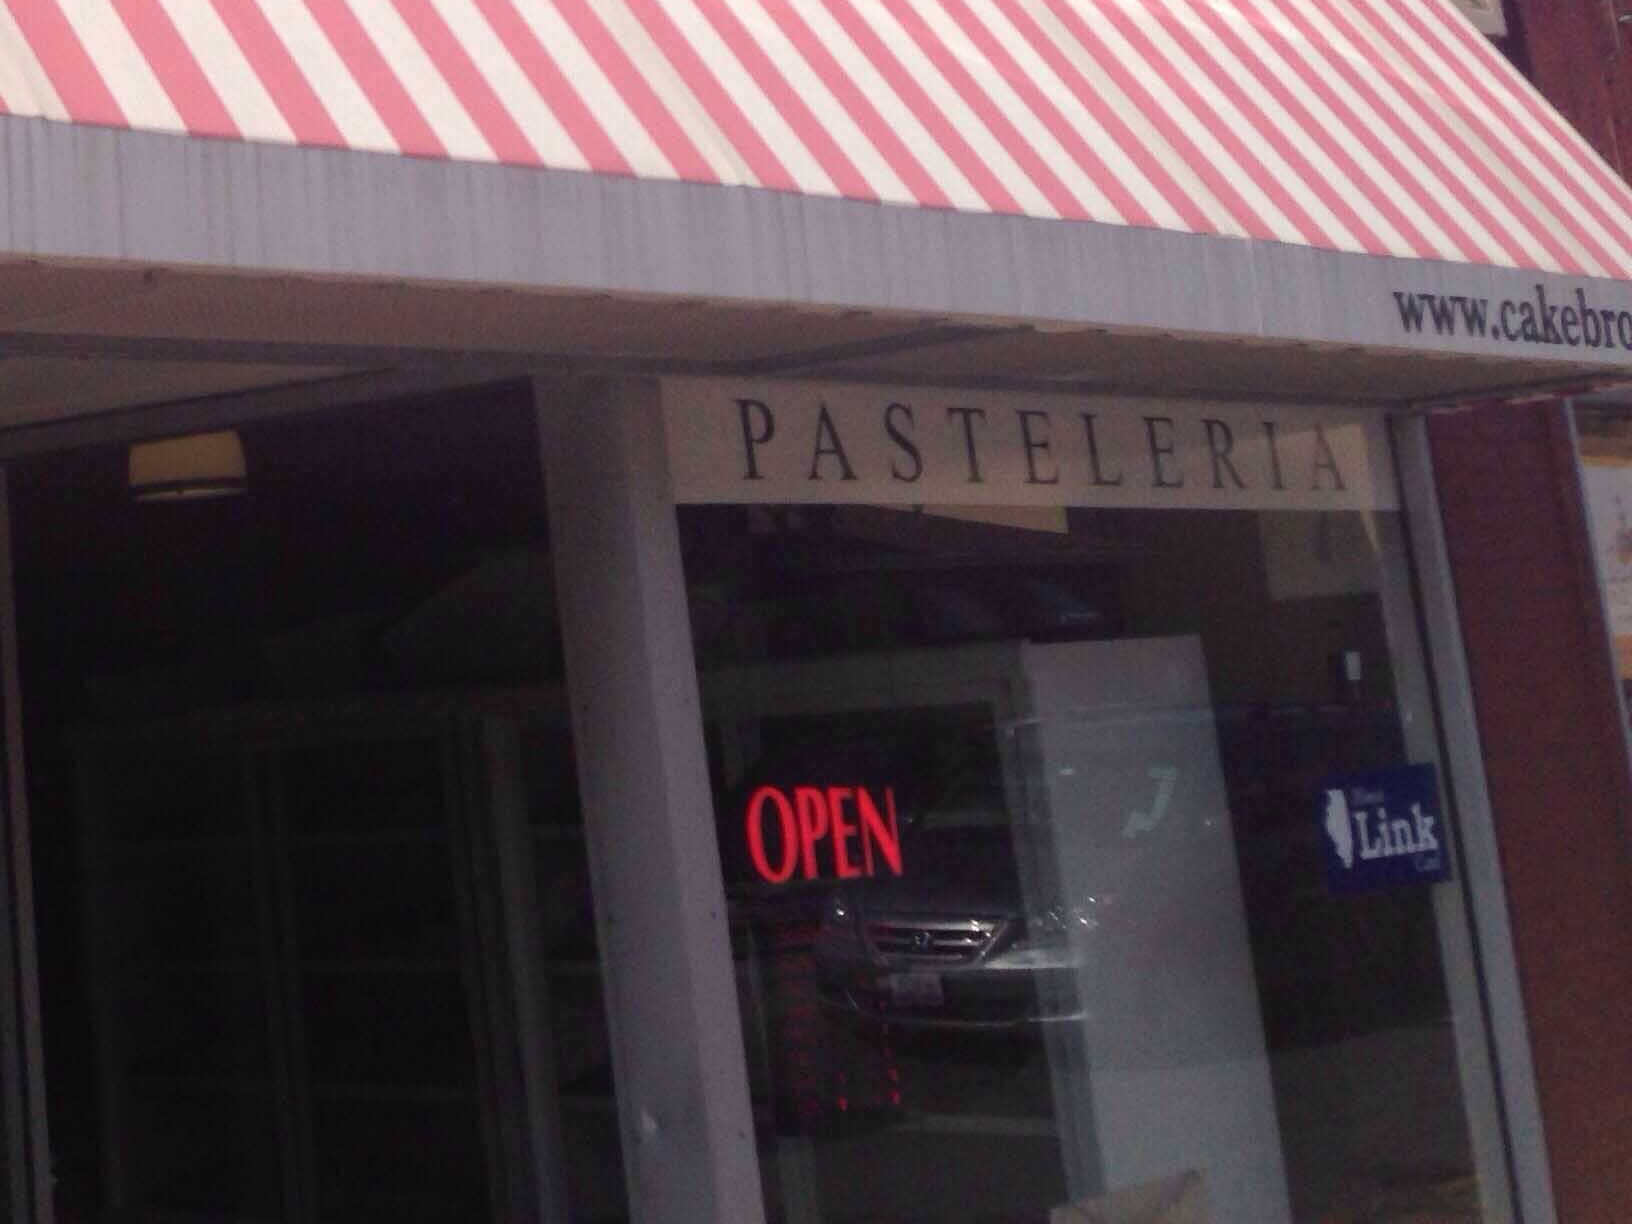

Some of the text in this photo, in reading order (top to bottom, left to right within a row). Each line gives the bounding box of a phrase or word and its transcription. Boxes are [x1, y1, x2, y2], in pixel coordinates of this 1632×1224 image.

[734, 397, 1348, 494] PASTELERIA
[744, 786, 904, 884] OPEN
[1353, 800, 1440, 861] Link
